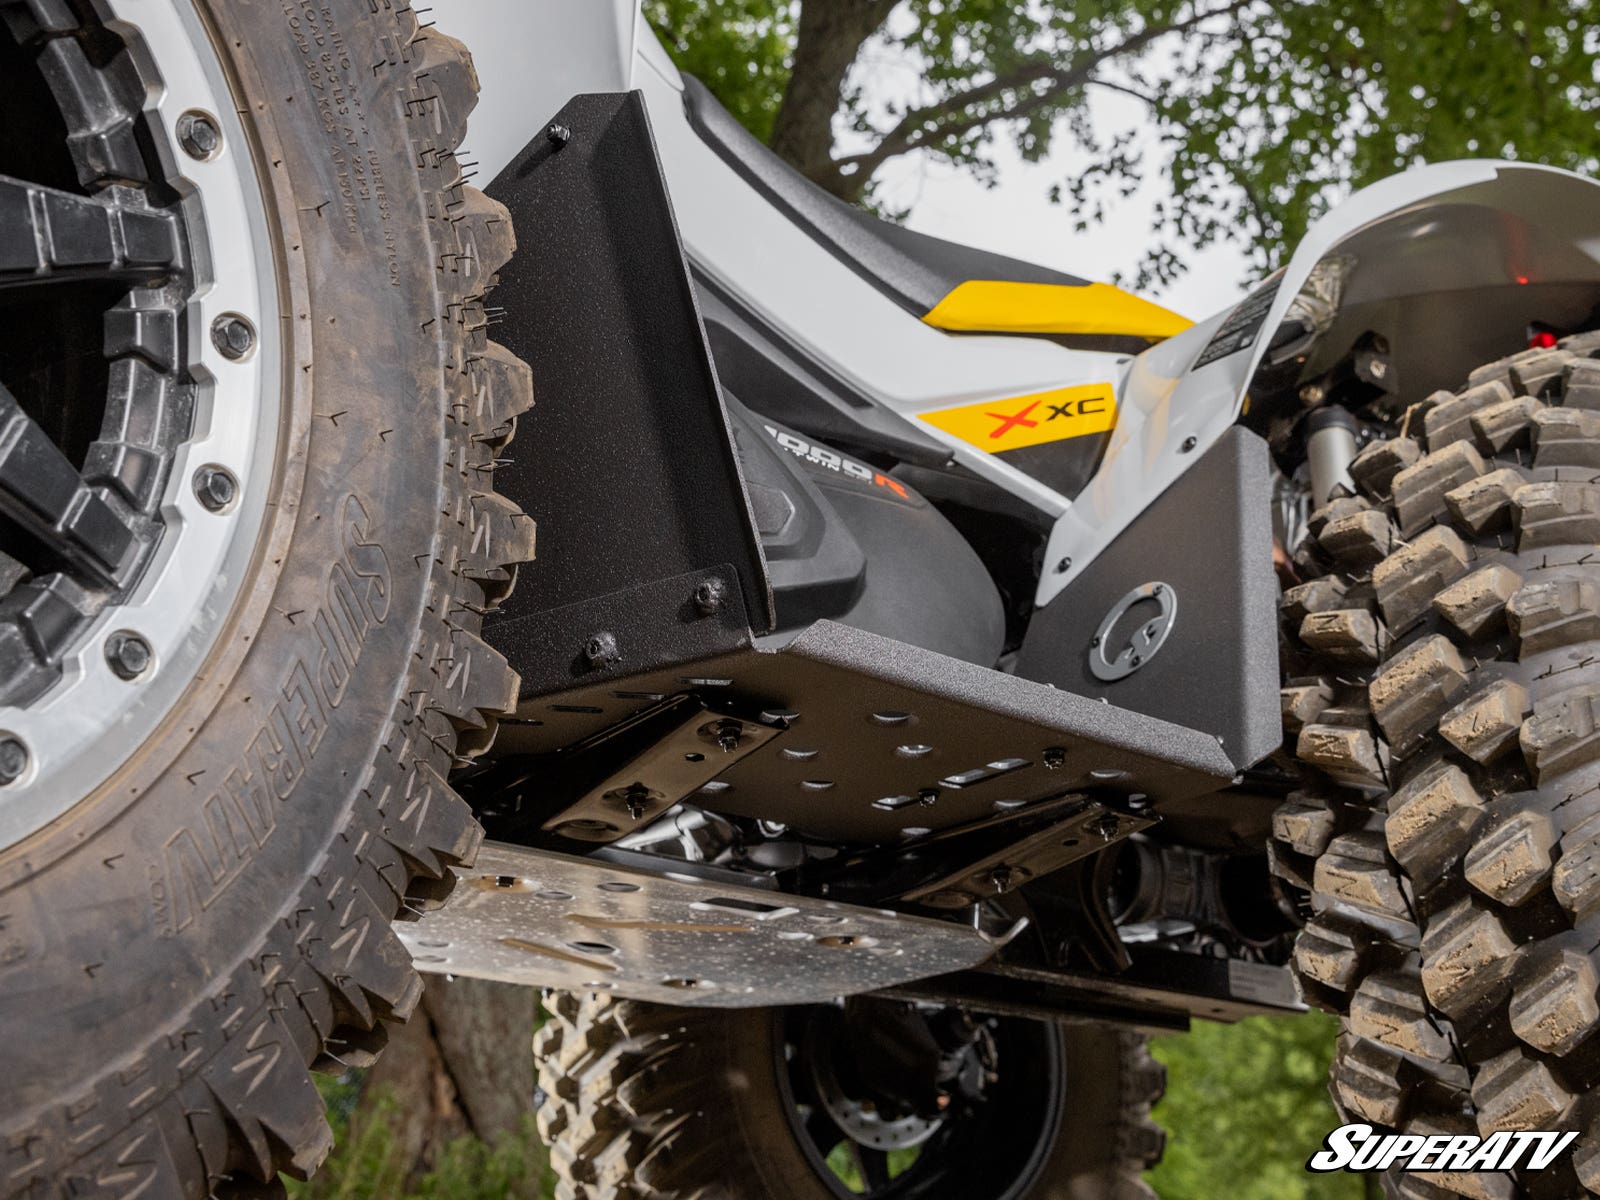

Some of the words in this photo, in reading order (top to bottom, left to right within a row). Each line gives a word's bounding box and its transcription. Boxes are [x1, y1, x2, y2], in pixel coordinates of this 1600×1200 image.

[300, 0, 325, 47] LOAD
[343, 127, 359, 147] AT
[320, 7, 351, 70] RATING
[366, 148, 392, 220] TUBELESS
[384, 231, 400, 286] NYLON
[1045, 397, 1105, 422] XC
[163, 494, 392, 934] SUPERATV
